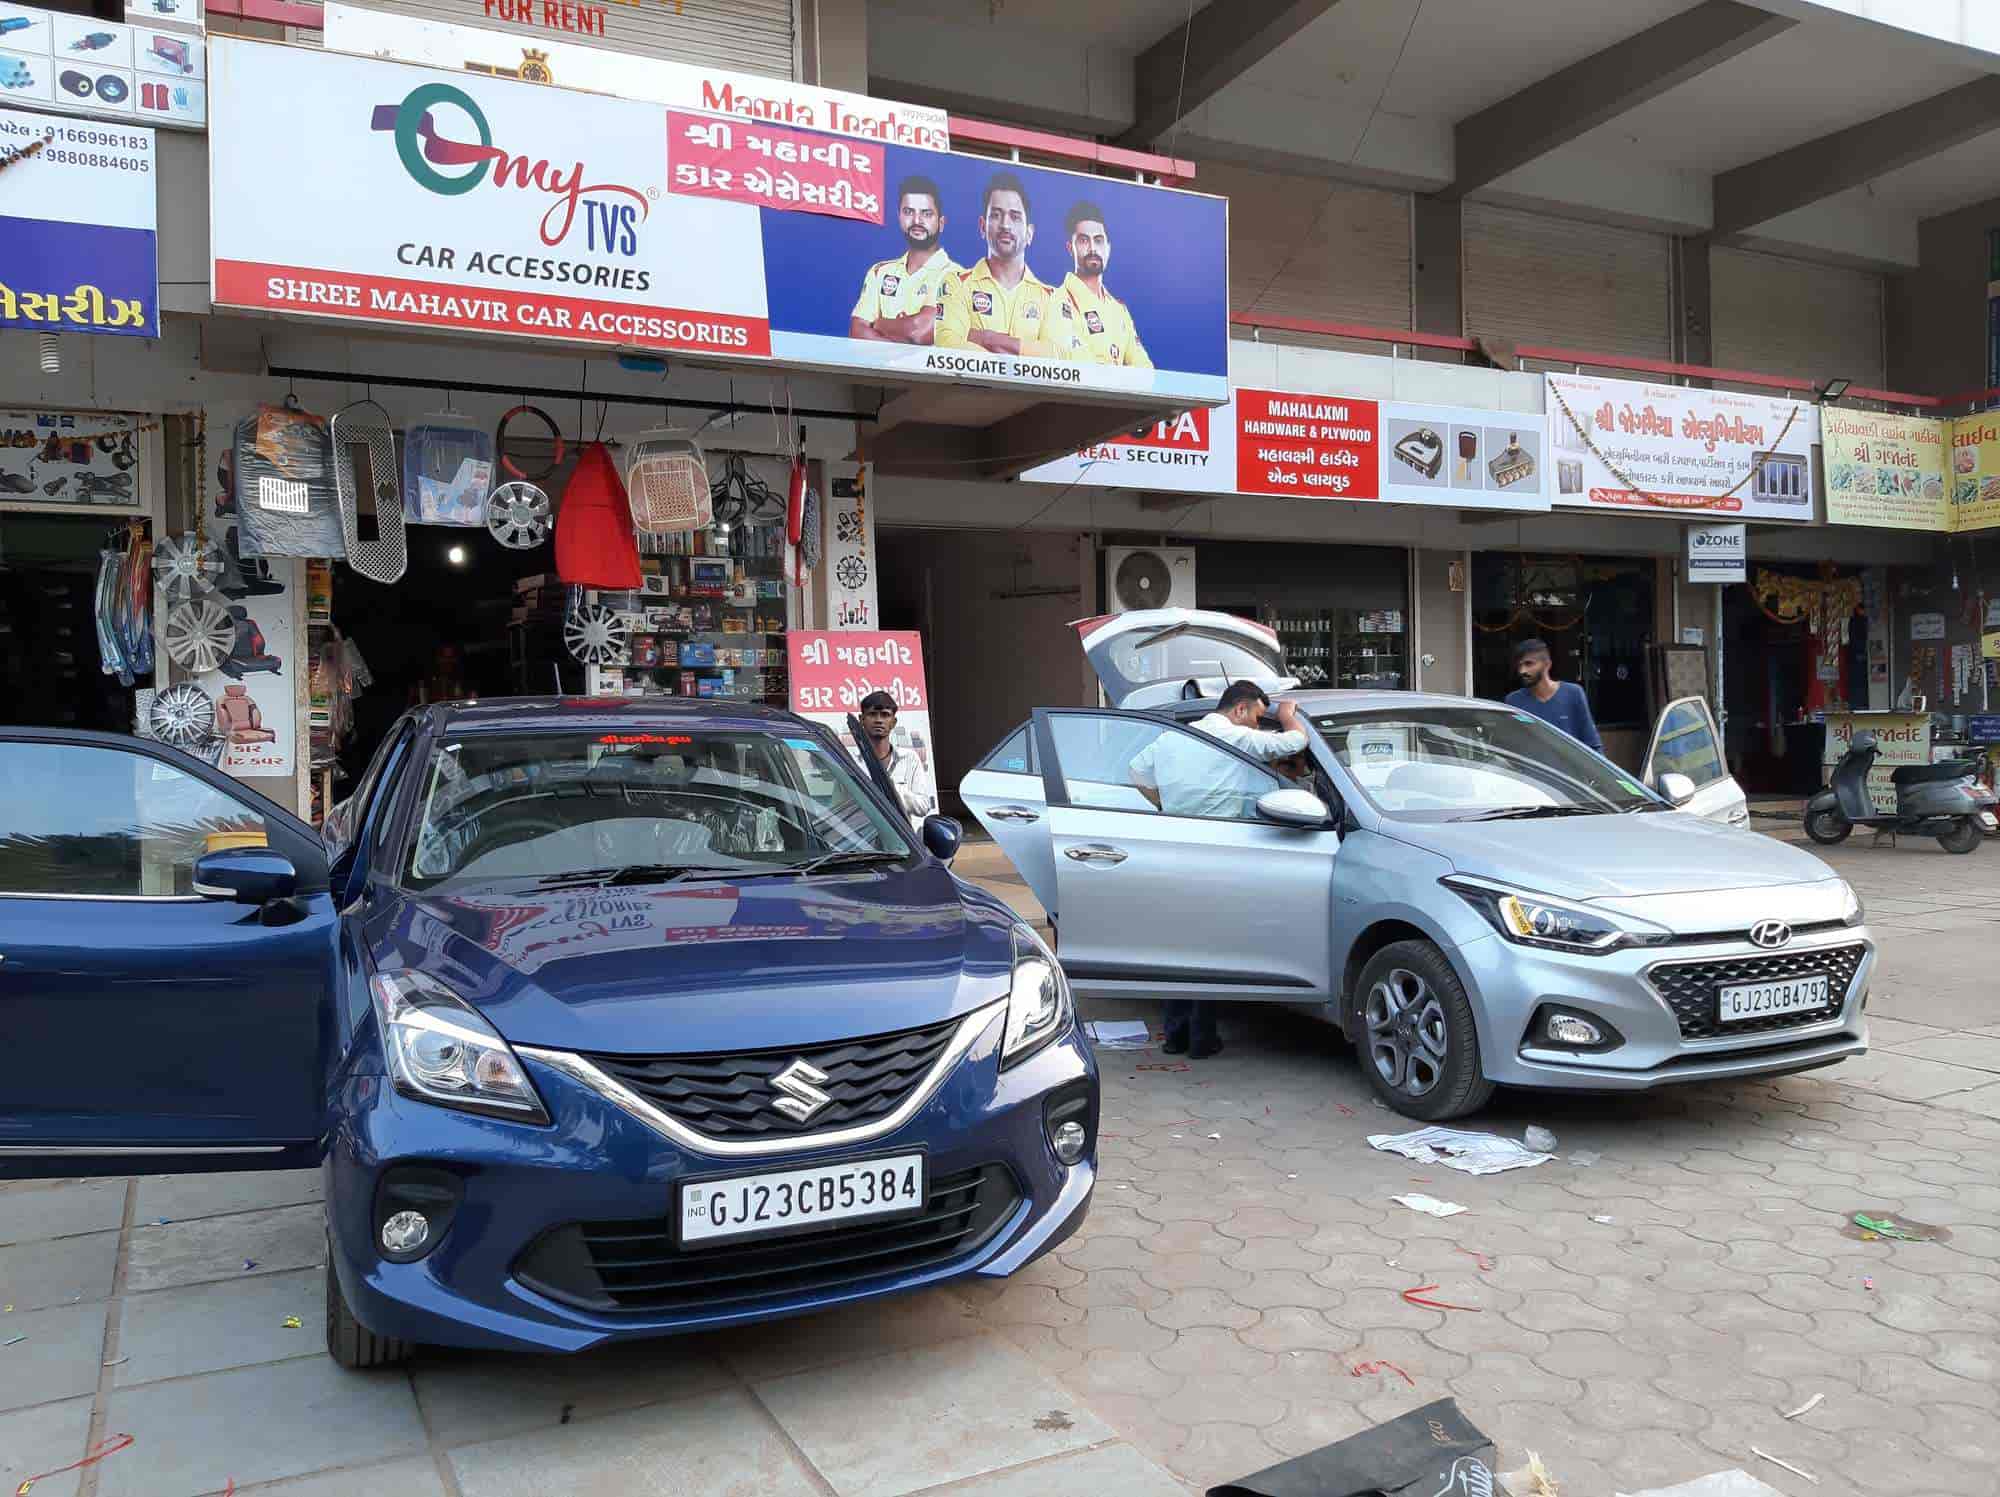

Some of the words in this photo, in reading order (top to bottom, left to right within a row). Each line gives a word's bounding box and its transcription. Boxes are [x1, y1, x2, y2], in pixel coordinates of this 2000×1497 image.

[543, 0, 609, 38] RENT
[702, 79, 815, 127] Mamta
[45, 126, 149, 151] 9166996183
[684, 121, 732, 151] શ્રી
[745, 134, 873, 174] મહાવીર
[47, 150, 150, 173] 9880884605
[675, 163, 733, 191] કાર
[742, 166, 880, 213] એસેસરીઝ
[582, 200, 638, 257] TVS
[396, 242, 456, 270] CAR
[466, 250, 651, 292] ACCESSORIES
[267, 276, 361, 307] SHREE
[370, 288, 509, 323] MAHAVIR
[516, 304, 572, 329] CAR
[578, 311, 749, 346] ACCESSORIES
[926, 354, 1007, 376] ASSOCIATE
[1012, 362, 1082, 382] SPONSOR
[1268, 399, 1349, 422] MAHALAXMI
[1244, 420, 1306, 438] HARDWARE
[1309, 425, 1318, 439] &
[1321, 426, 1372, 443] PLYWOOD
[1126, 448, 1209, 467] SECURITY
[1257, 447, 1315, 465] મહાલક્ષ્મી
[1266, 466, 1298, 485] એન્ડ
[1302, 472, 1351, 493] પ્લાયવુડ
[800, 637, 830, 666] શ્રી
[836, 638, 913, 668] મહાવીર
[799, 686, 834, 708] કાર
[1732, 980, 1827, 1013] GJ23CB4792
[709, 1165, 916, 1227] GJ23CB5384
[687, 1206, 707, 1217] IND
